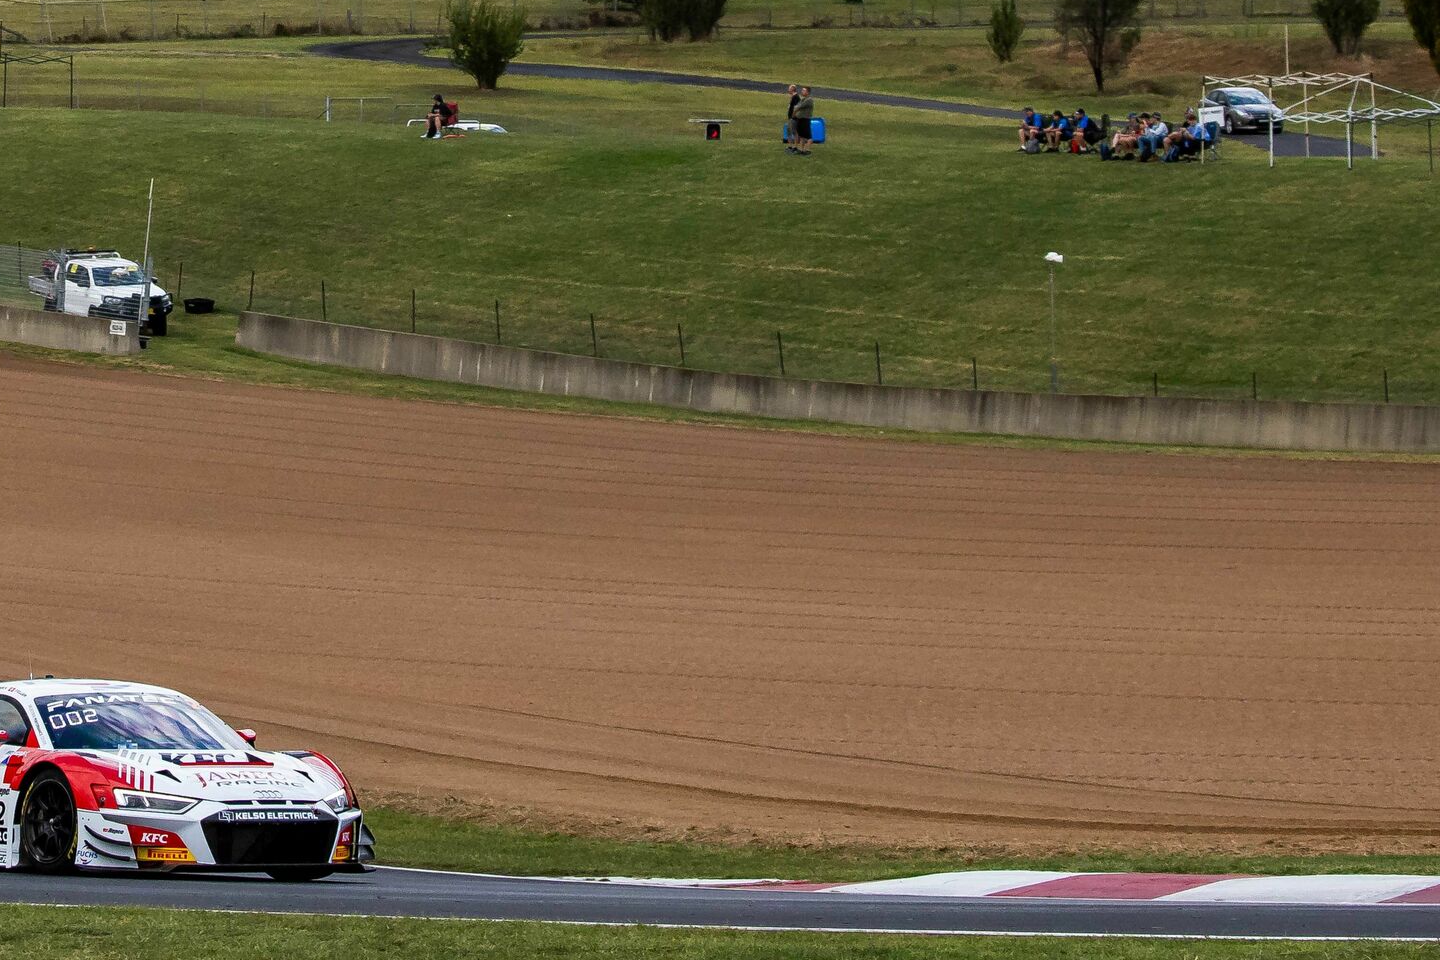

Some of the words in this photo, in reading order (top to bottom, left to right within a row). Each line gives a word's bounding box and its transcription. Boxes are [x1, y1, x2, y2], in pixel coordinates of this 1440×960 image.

[48, 708, 98, 730] 002
[234, 812, 265, 820] KELSO
[266, 812, 319, 820] ELECTRICAL
[141, 832, 169, 844] KFC
[77, 849, 98, 860] FUCHS
[148, 848, 189, 860] PIRELLI
